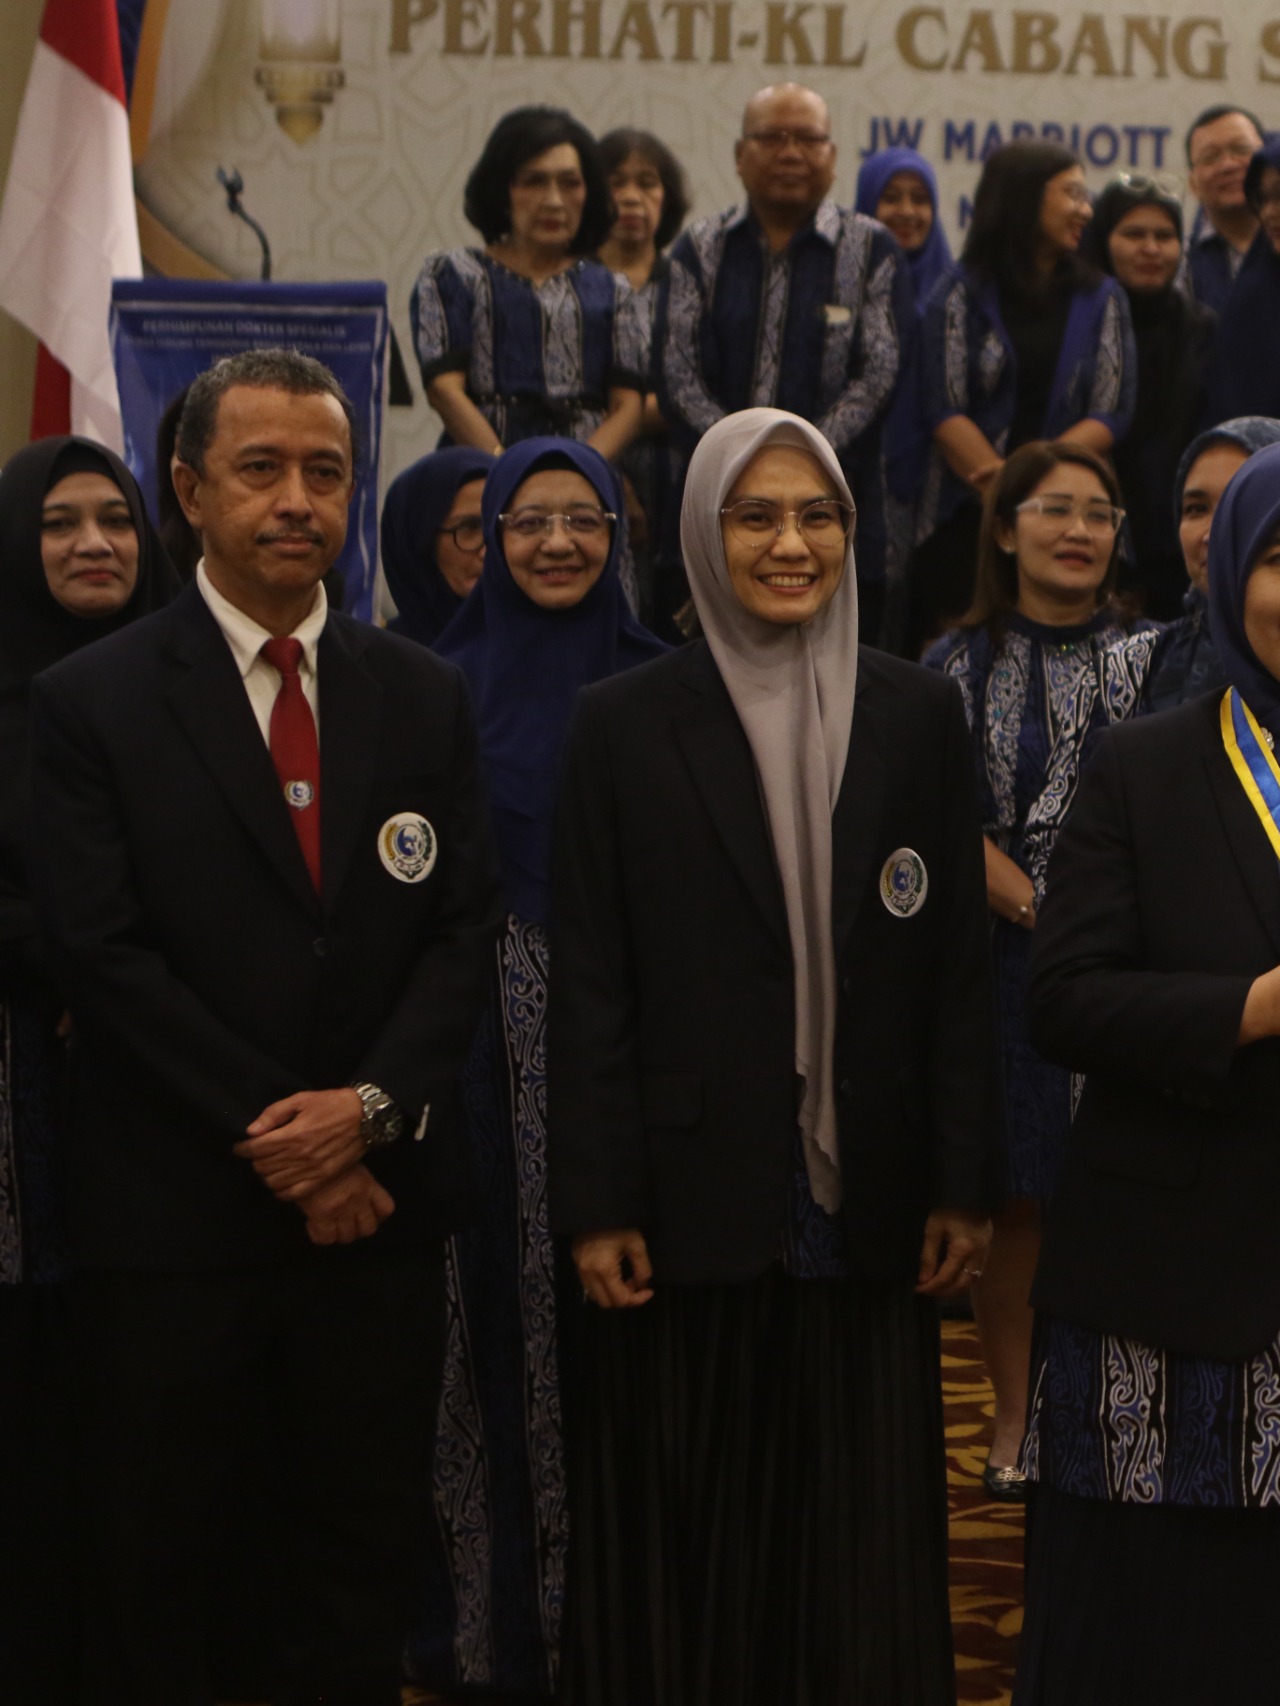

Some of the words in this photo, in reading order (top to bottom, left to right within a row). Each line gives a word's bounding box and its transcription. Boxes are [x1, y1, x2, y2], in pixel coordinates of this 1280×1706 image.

[388, 0, 868, 68] PERHATI-KL
[896, 6, 1229, 81] CABANG
[859, 117, 924, 159] JW
